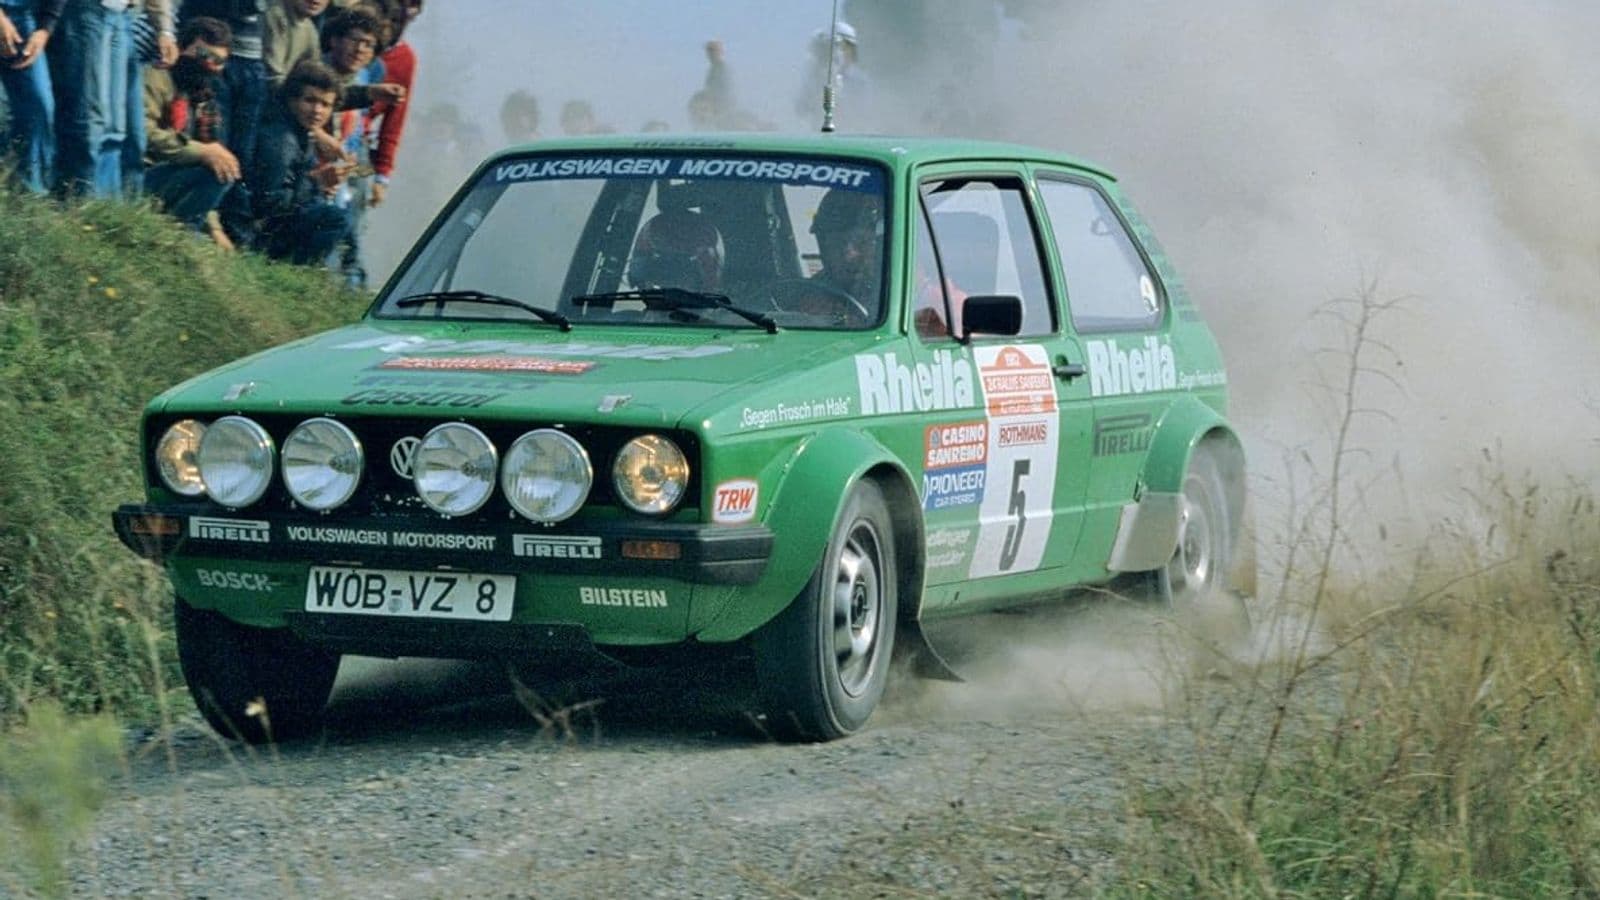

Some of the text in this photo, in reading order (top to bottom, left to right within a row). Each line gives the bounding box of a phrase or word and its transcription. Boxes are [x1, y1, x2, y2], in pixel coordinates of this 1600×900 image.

[496, 159, 870, 187] VOLKSWAGEN MOTORSPORT
[1087, 335, 1176, 397] Rheila
[855, 348, 974, 416] Rheila
[778, 402, 811, 421] Frosch
[812, 399, 826, 418] im
[942, 424, 985, 445] CASINO
[1000, 424, 1047, 442] ROTHMANS
[1094, 413, 1151, 457] PIRELLI
[928, 445, 985, 466] SANREMO
[929, 470, 984, 495] PIONEER
[718, 487, 755, 512] TRW
[998, 459, 1030, 571] 5
[190, 516, 270, 542] PIRELLI
[288, 526, 496, 551] VOLKSWAGEN MOTORSPORT
[512, 534, 602, 558] PIRELLI
[476, 579, 496, 613] 8
[580, 587, 667, 607] BILSTEIN
